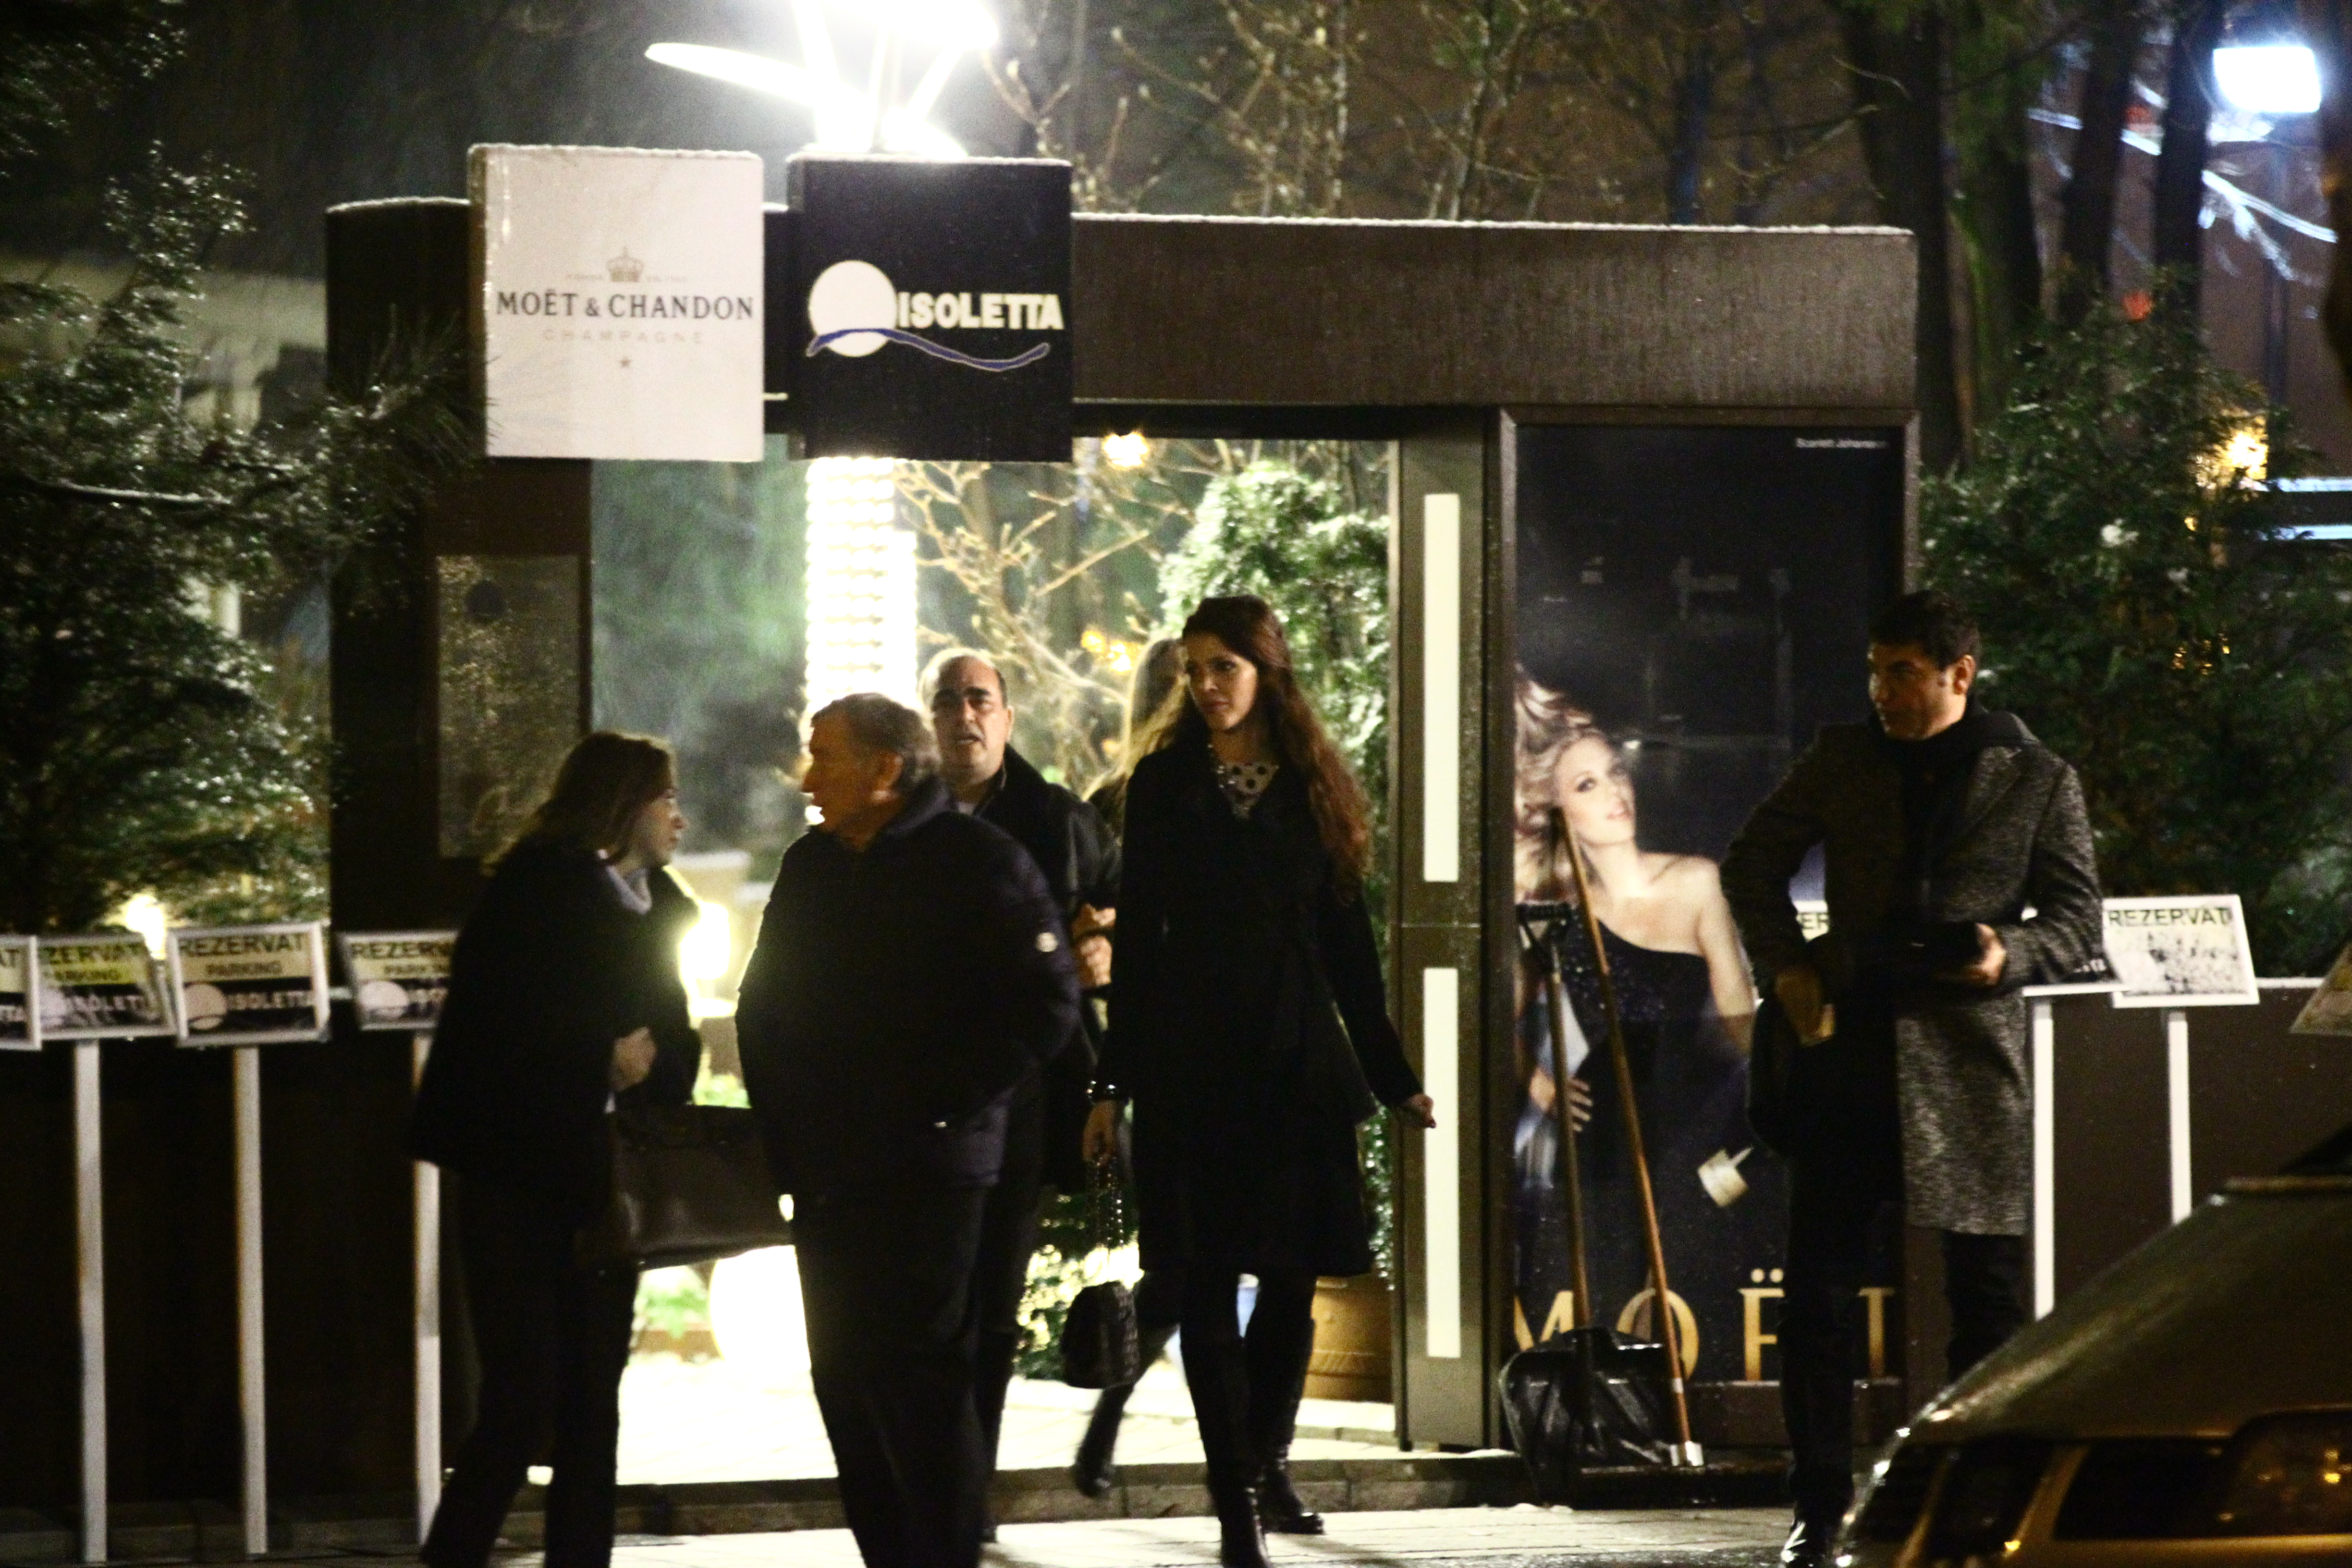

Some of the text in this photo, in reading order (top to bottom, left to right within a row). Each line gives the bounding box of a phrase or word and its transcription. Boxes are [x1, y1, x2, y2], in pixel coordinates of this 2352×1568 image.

[585, 296, 600, 317] &
[608, 294, 753, 321] CHANDON
[897, 291, 1065, 330] ISOLETTA
[543, 329, 702, 344] CHAMPAGNE
[180, 933, 306, 957] REZERVAT
